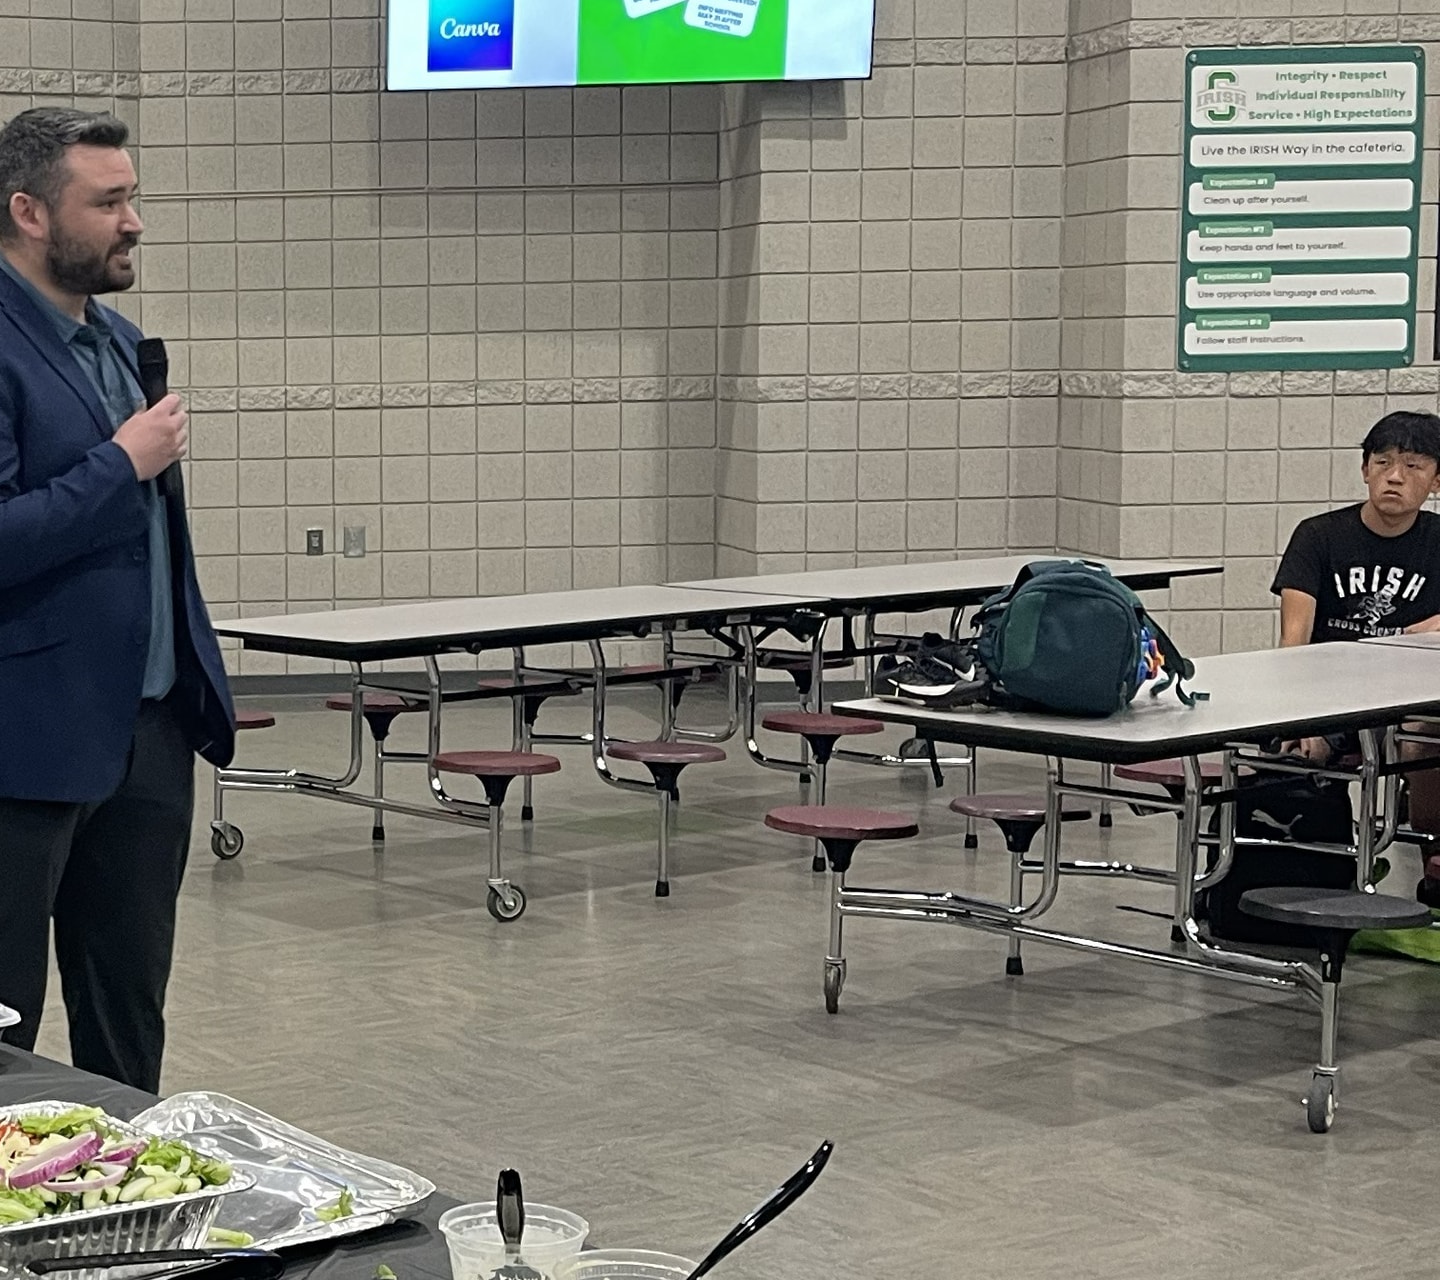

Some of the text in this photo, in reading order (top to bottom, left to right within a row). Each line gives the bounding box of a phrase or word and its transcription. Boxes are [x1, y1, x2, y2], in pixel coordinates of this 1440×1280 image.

[440, 17, 501, 39] Canva
[1275, 70, 1387, 83] Integrity Respect
[1196, 91, 1247, 109] IRISH
[1256, 89, 1406, 102] Individual Responsibility
[1248, 107, 1413, 121] Service High Expectations
[1201, 142, 1406, 157] Live the IRISH Way in the cafeteria.
[1203, 196, 1230, 205] Clean
[1233, 197, 1244, 206] up
[1247, 196, 1269, 204] after
[1199, 245, 1223, 253] Keep
[1224, 243, 1253, 251] hands
[1255, 243, 1274, 251] and
[1276, 242, 1294, 250] feet
[1296, 242, 1305, 250] to
[1197, 287, 1377, 300] Use appropriate language and volume.
[1196, 335, 1305, 345] Follow staff instructions.
[1334, 565, 1426, 601] IRISH
[1328, 618, 1360, 631] CROSS
